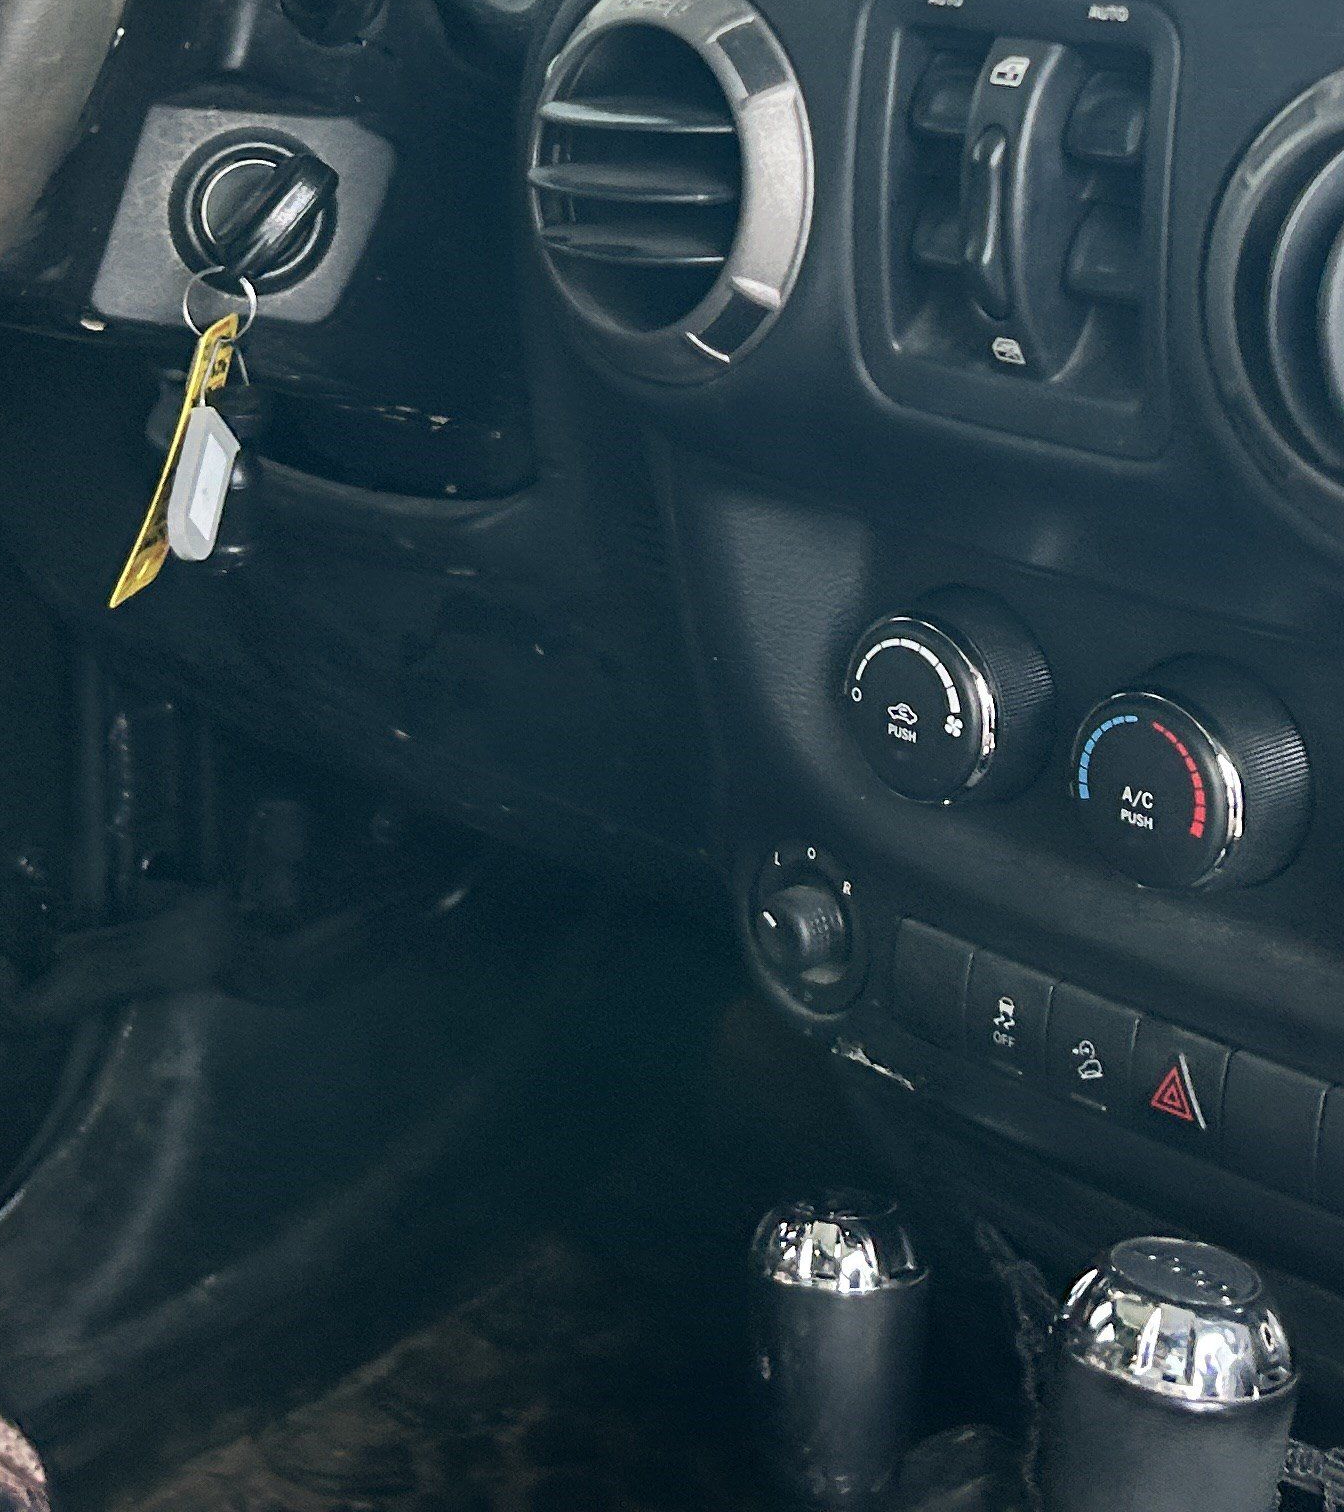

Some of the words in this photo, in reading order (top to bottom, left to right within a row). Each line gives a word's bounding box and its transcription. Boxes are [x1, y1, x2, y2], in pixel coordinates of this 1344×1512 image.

[1088, 5, 1129, 23] AUTO
[887, 723, 917, 744] PUSH
[1121, 786, 1154, 810] A/C
[1119, 808, 1154, 831] PUSH
[774, 851, 782, 867] L
[843, 881, 852, 896] R
[992, 1030, 1016, 1049] OFF
